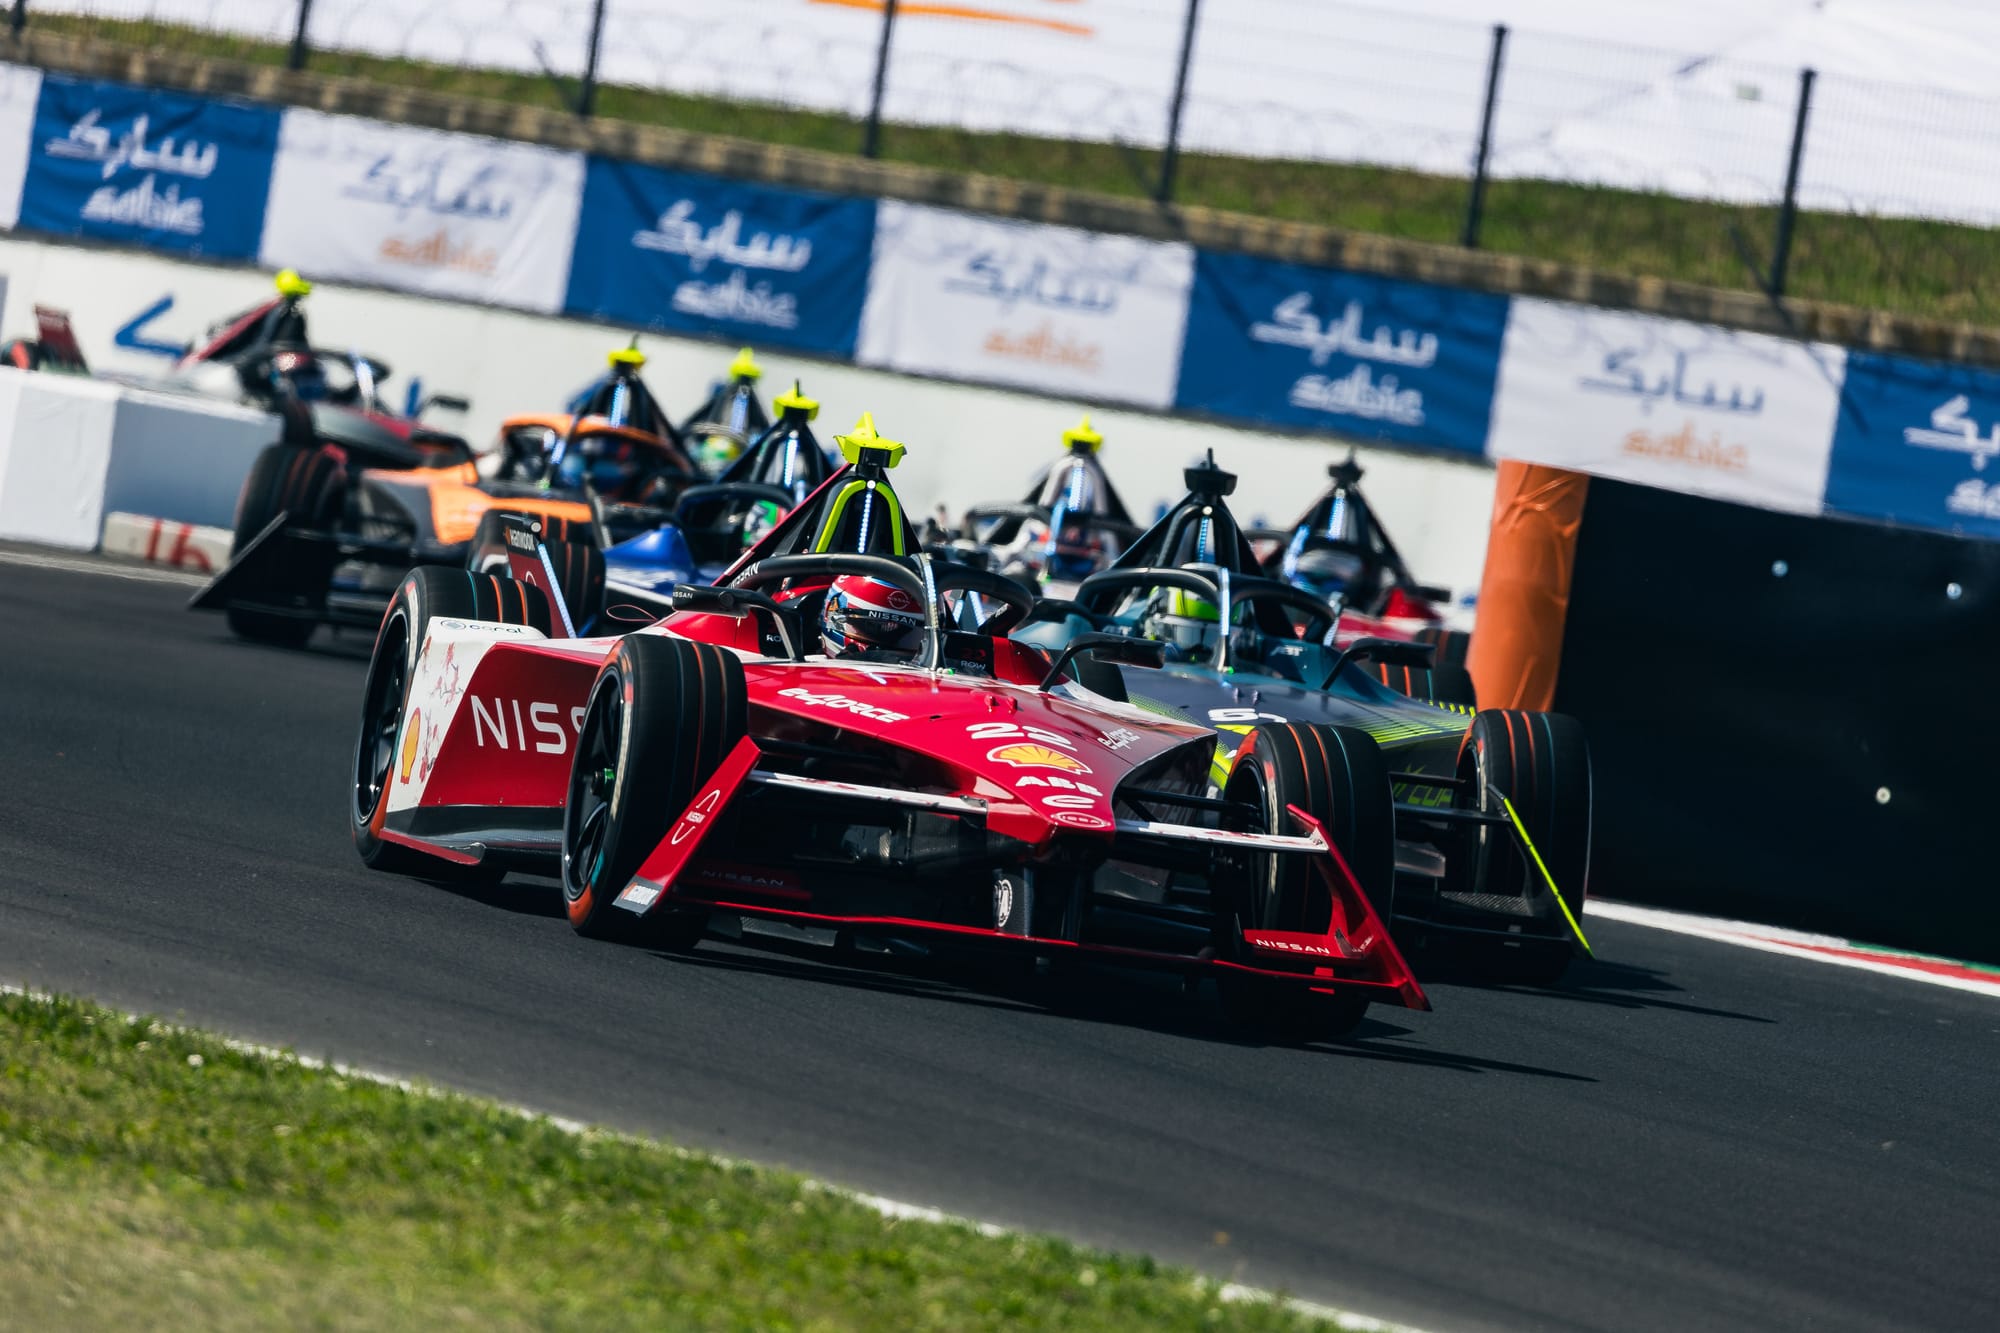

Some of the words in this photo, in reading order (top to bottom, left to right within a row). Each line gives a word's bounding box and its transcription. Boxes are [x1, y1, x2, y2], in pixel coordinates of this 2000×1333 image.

[868, 610, 917, 627] NISSAN
[766, 634, 782, 642] RO
[961, 660, 986, 670] ROW
[470, 695, 584, 755] NIS
[966, 722, 1078, 752] 22
[702, 870, 784, 886] NISSAN
[1256, 938, 1330, 955] NISSAN
